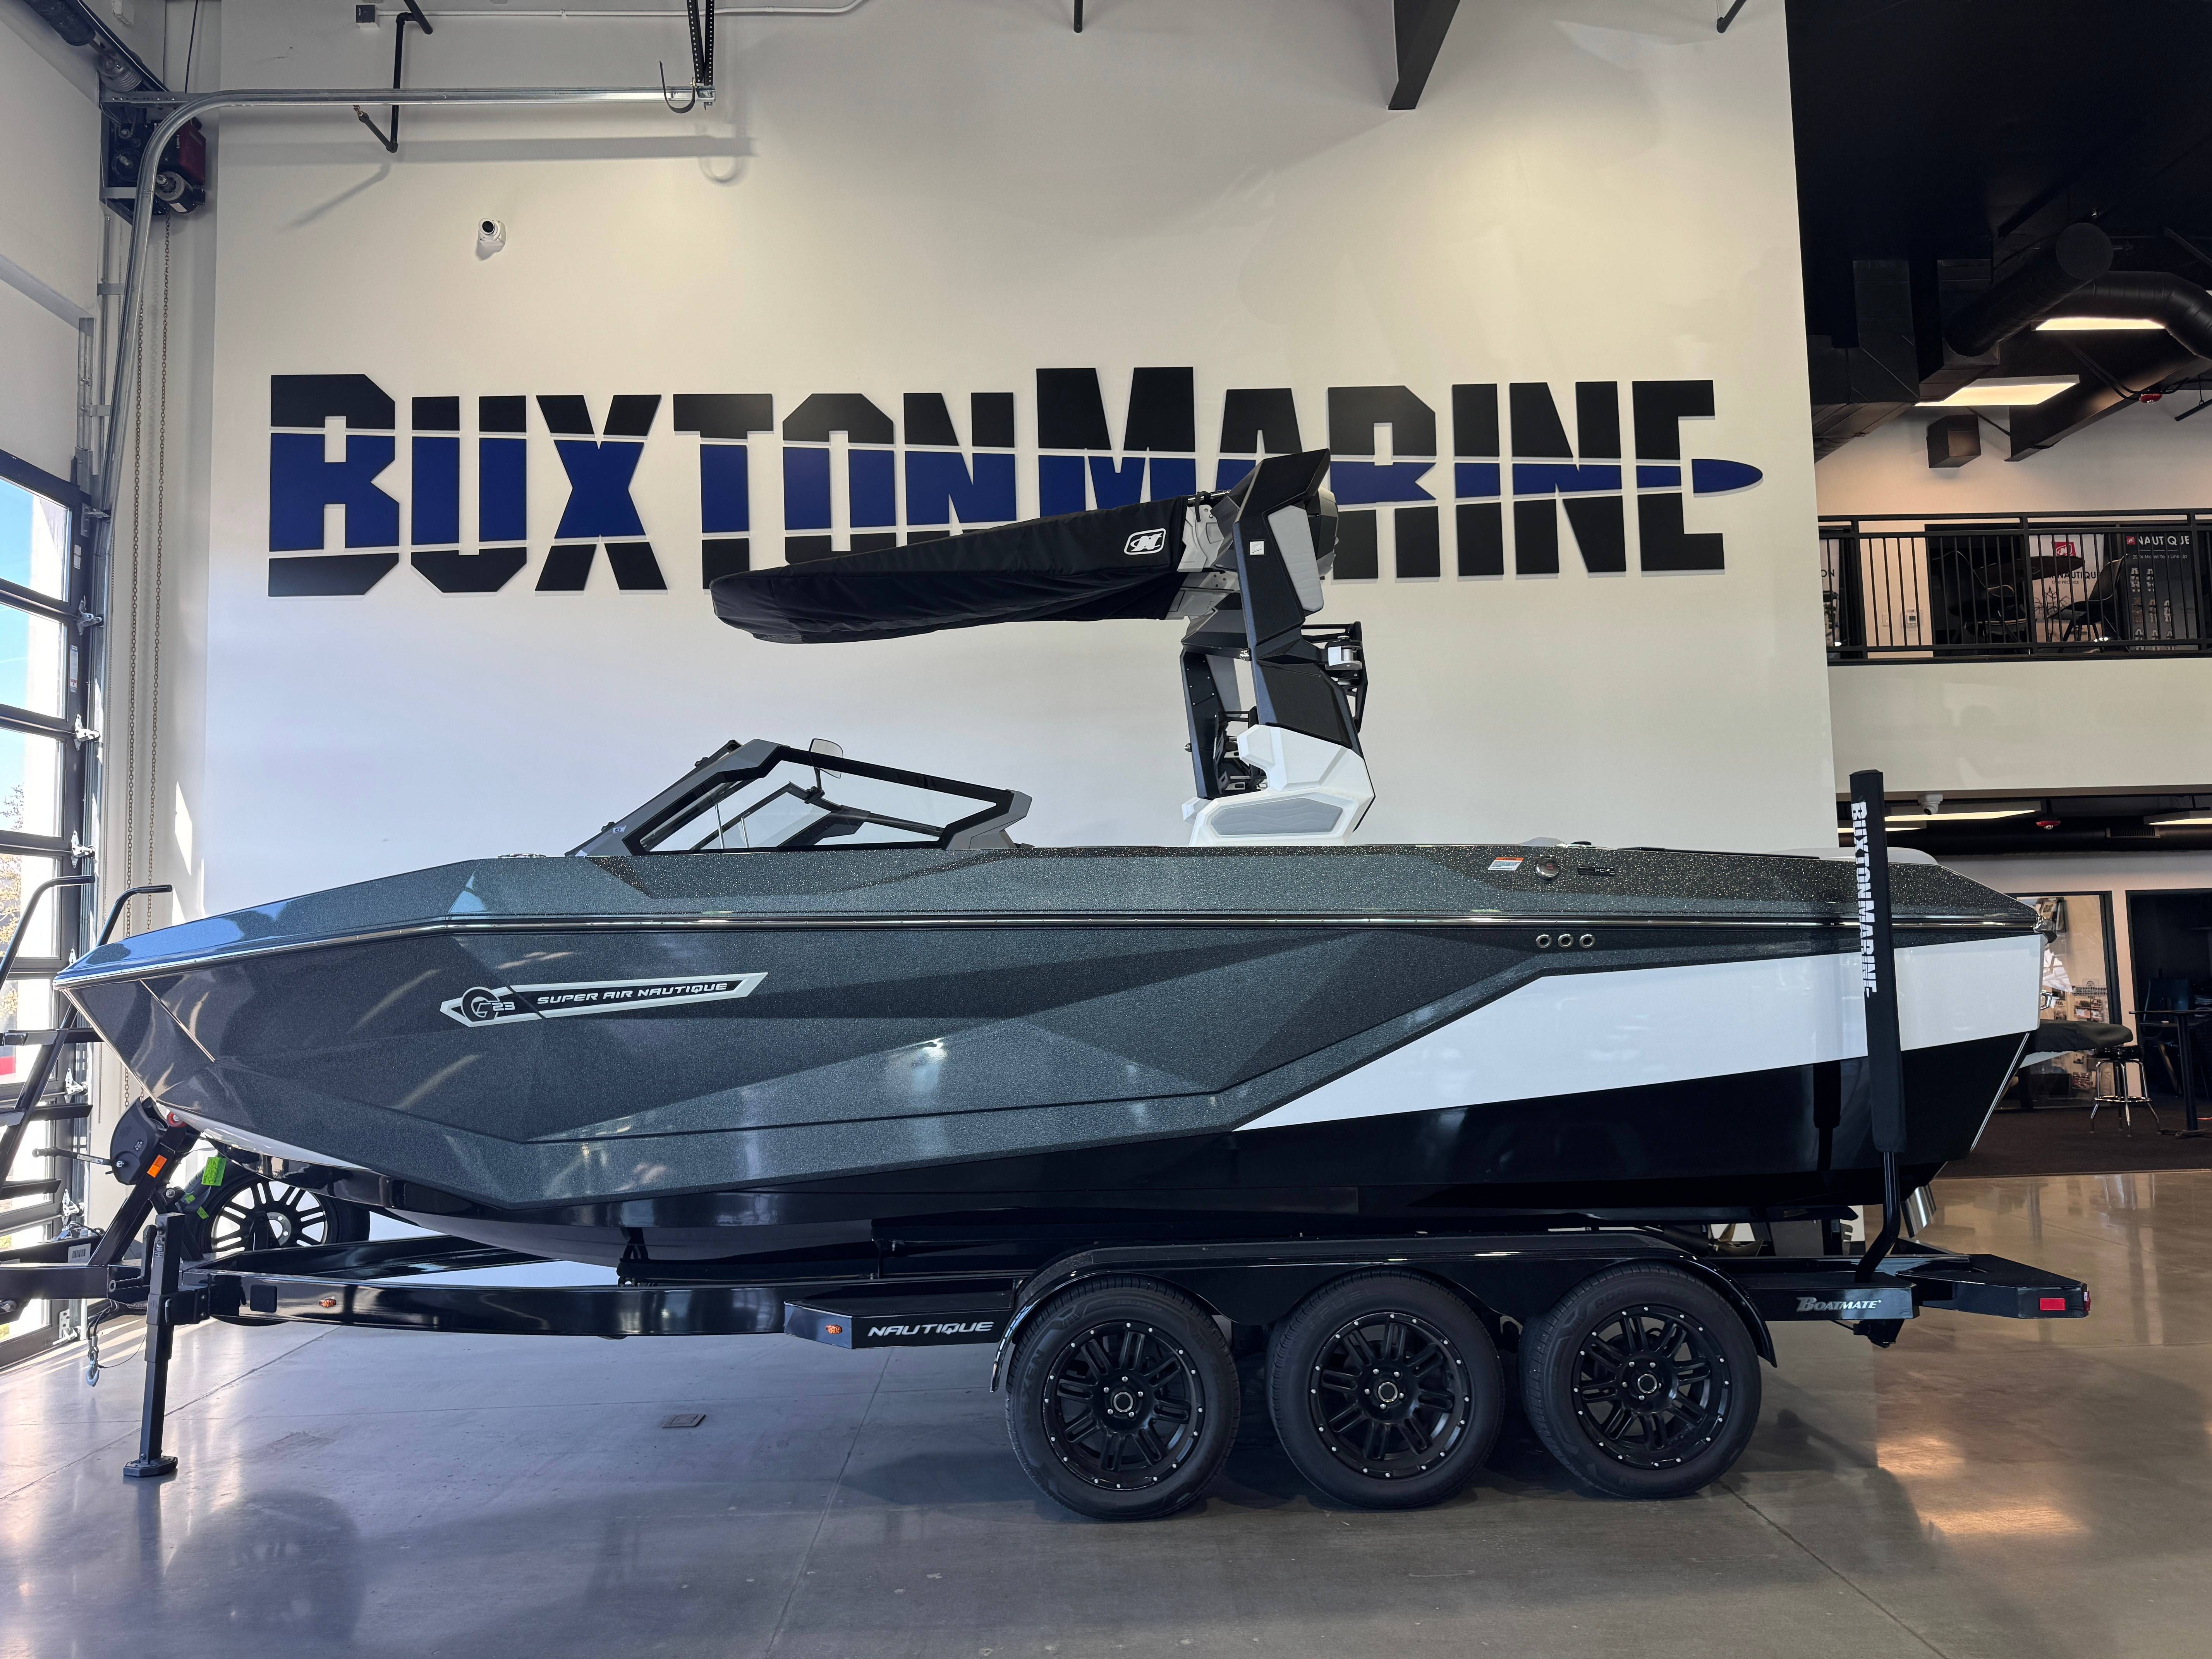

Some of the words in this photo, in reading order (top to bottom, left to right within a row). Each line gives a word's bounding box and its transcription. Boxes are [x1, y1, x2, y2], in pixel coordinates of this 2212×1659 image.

[2138, 536, 2190, 545] NAUTQUE
[537, 993, 598, 1005] SUPER
[603, 990, 632, 999] AIR
[637, 982, 728, 997] NAUTIQUE
[867, 1321, 994, 1337] NAUTIQUE
